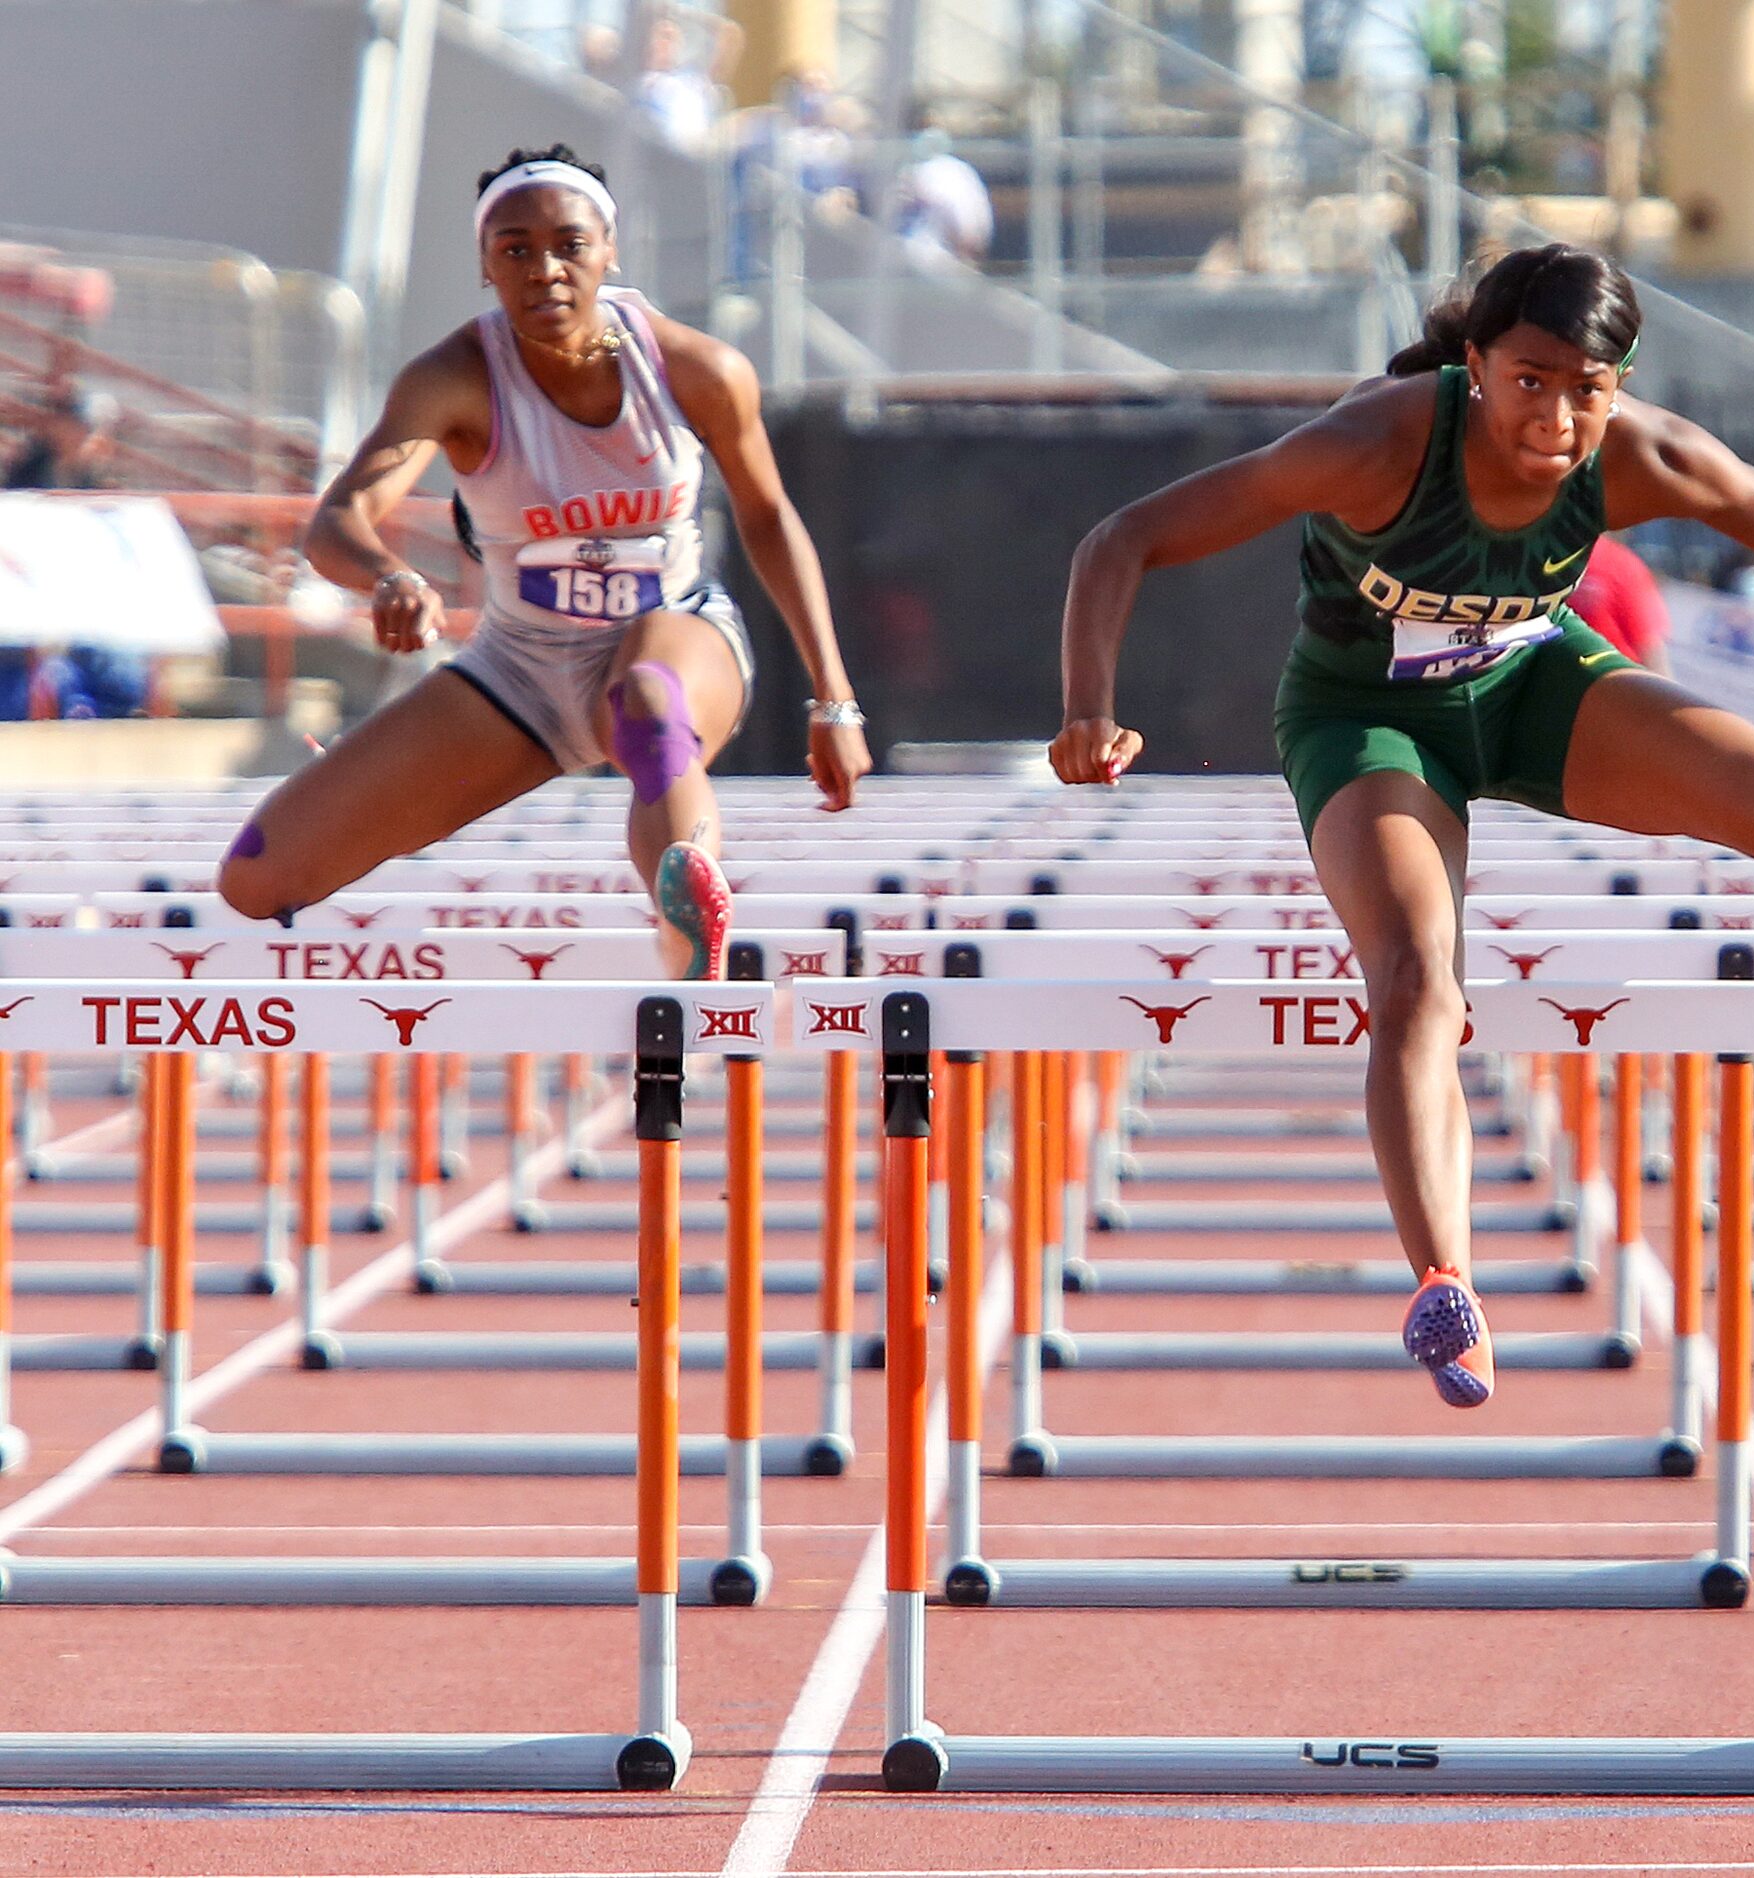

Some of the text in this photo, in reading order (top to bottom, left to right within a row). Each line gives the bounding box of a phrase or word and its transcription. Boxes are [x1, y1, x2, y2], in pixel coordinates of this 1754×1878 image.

[521, 481, 688, 538] BOWIE
[550, 568, 642, 617] 158
[1359, 562, 1588, 622] DESOT
[267, 943, 445, 979] TEXAS
[781, 952, 828, 976] XII
[878, 952, 925, 976] XII
[1256, 945, 1357, 978] TEX
[82, 997, 296, 1046] TEXAS
[699, 1009, 758, 1038] XII
[808, 1003, 867, 1034] XII
[1303, 1742, 1440, 1768] UCS
